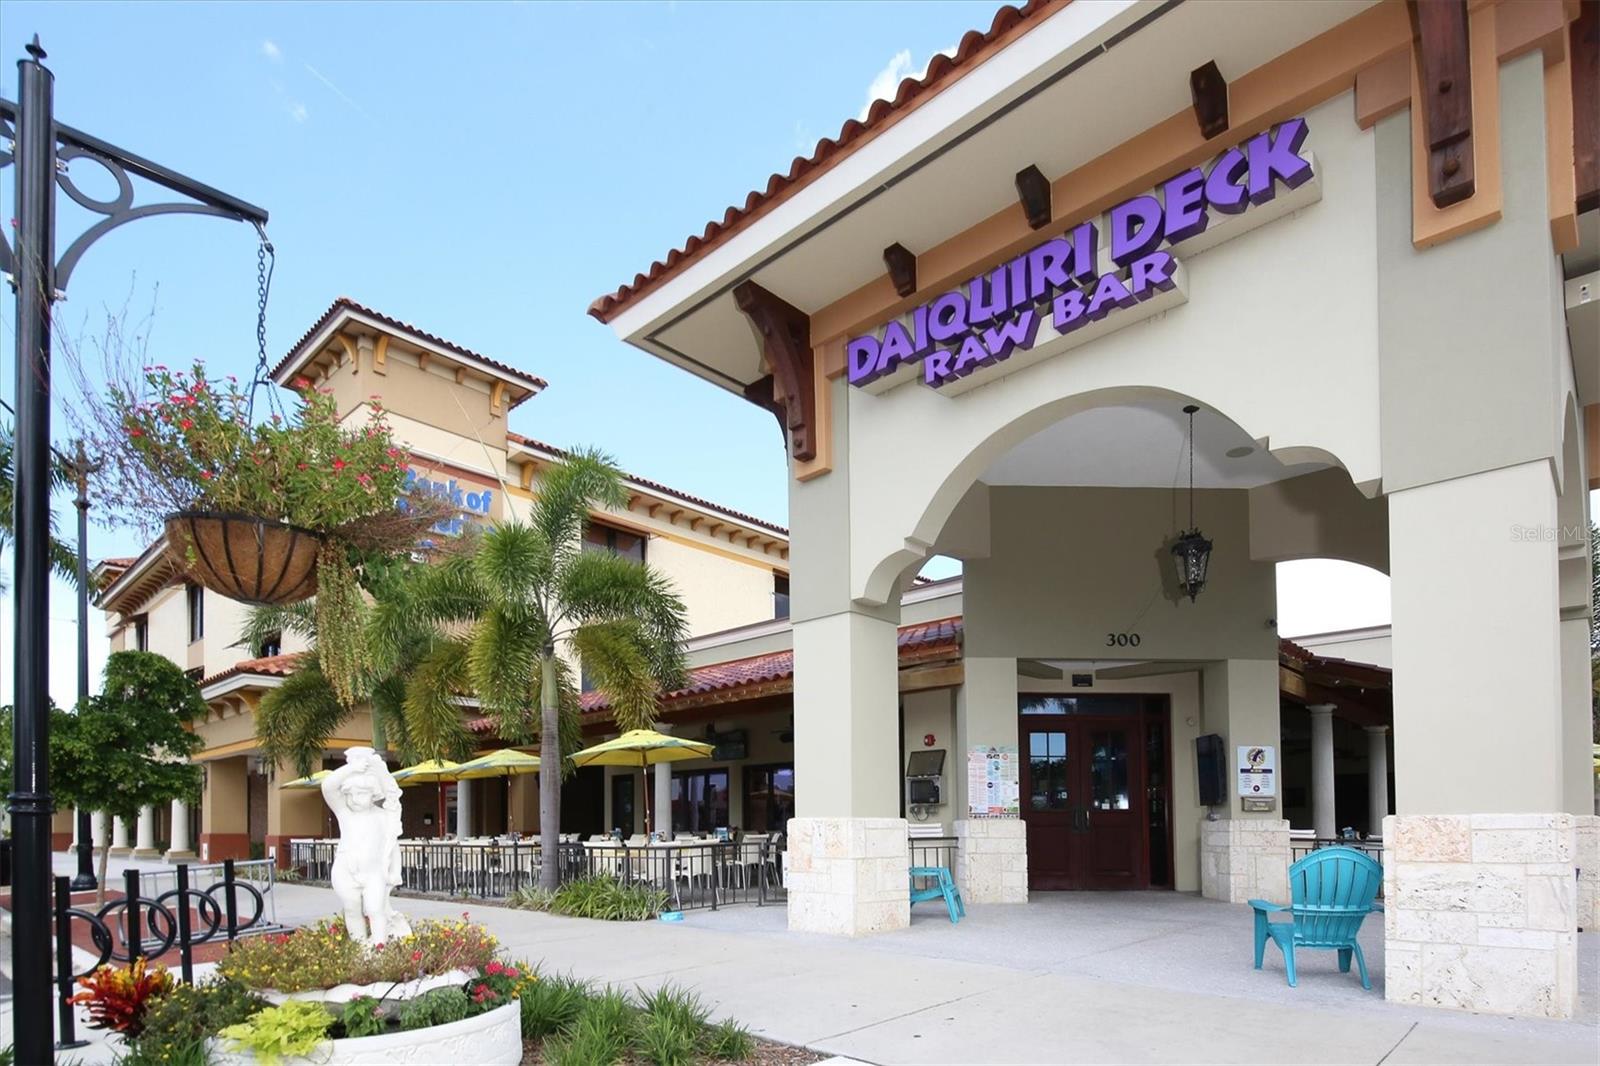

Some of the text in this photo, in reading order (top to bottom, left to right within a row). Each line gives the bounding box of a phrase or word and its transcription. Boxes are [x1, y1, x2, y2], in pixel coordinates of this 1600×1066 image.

[847, 117, 1314, 388] DAIQUIRI DECK
[923, 250, 1176, 389] RAW BAR
[466, 490, 492, 514] of
[1105, 633, 1141, 647] 300
